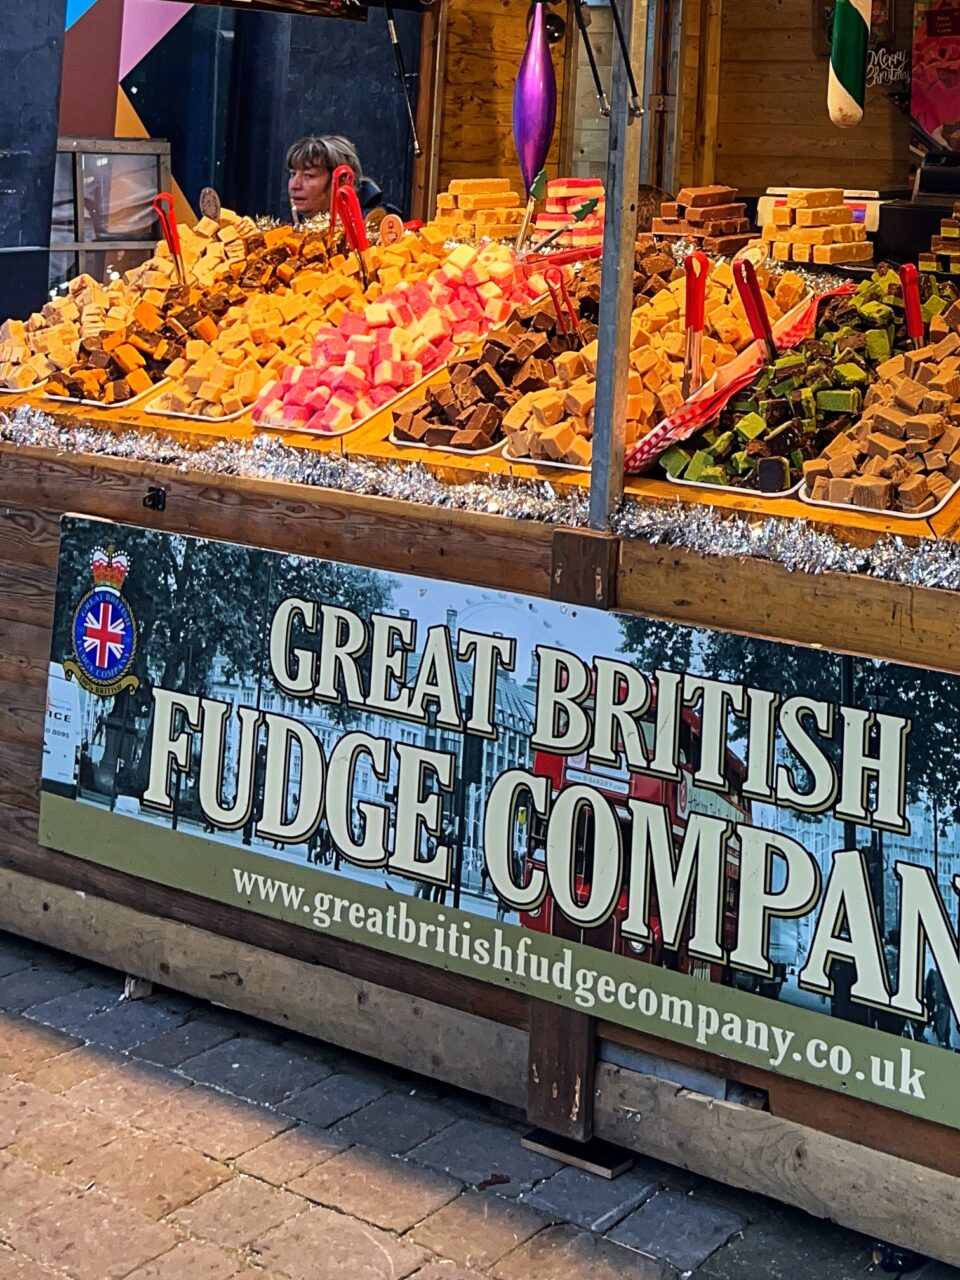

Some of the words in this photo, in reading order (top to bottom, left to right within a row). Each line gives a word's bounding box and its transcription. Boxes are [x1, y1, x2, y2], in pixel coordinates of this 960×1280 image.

[867, 48, 909, 72] Merry
[143, 686, 456, 887] FUDGE
[269, 598, 516, 739] GREAT
[531, 644, 911, 833] BRITISH
[233, 867, 927, 1099] www.greatbritishfudgecompany.co.uk
